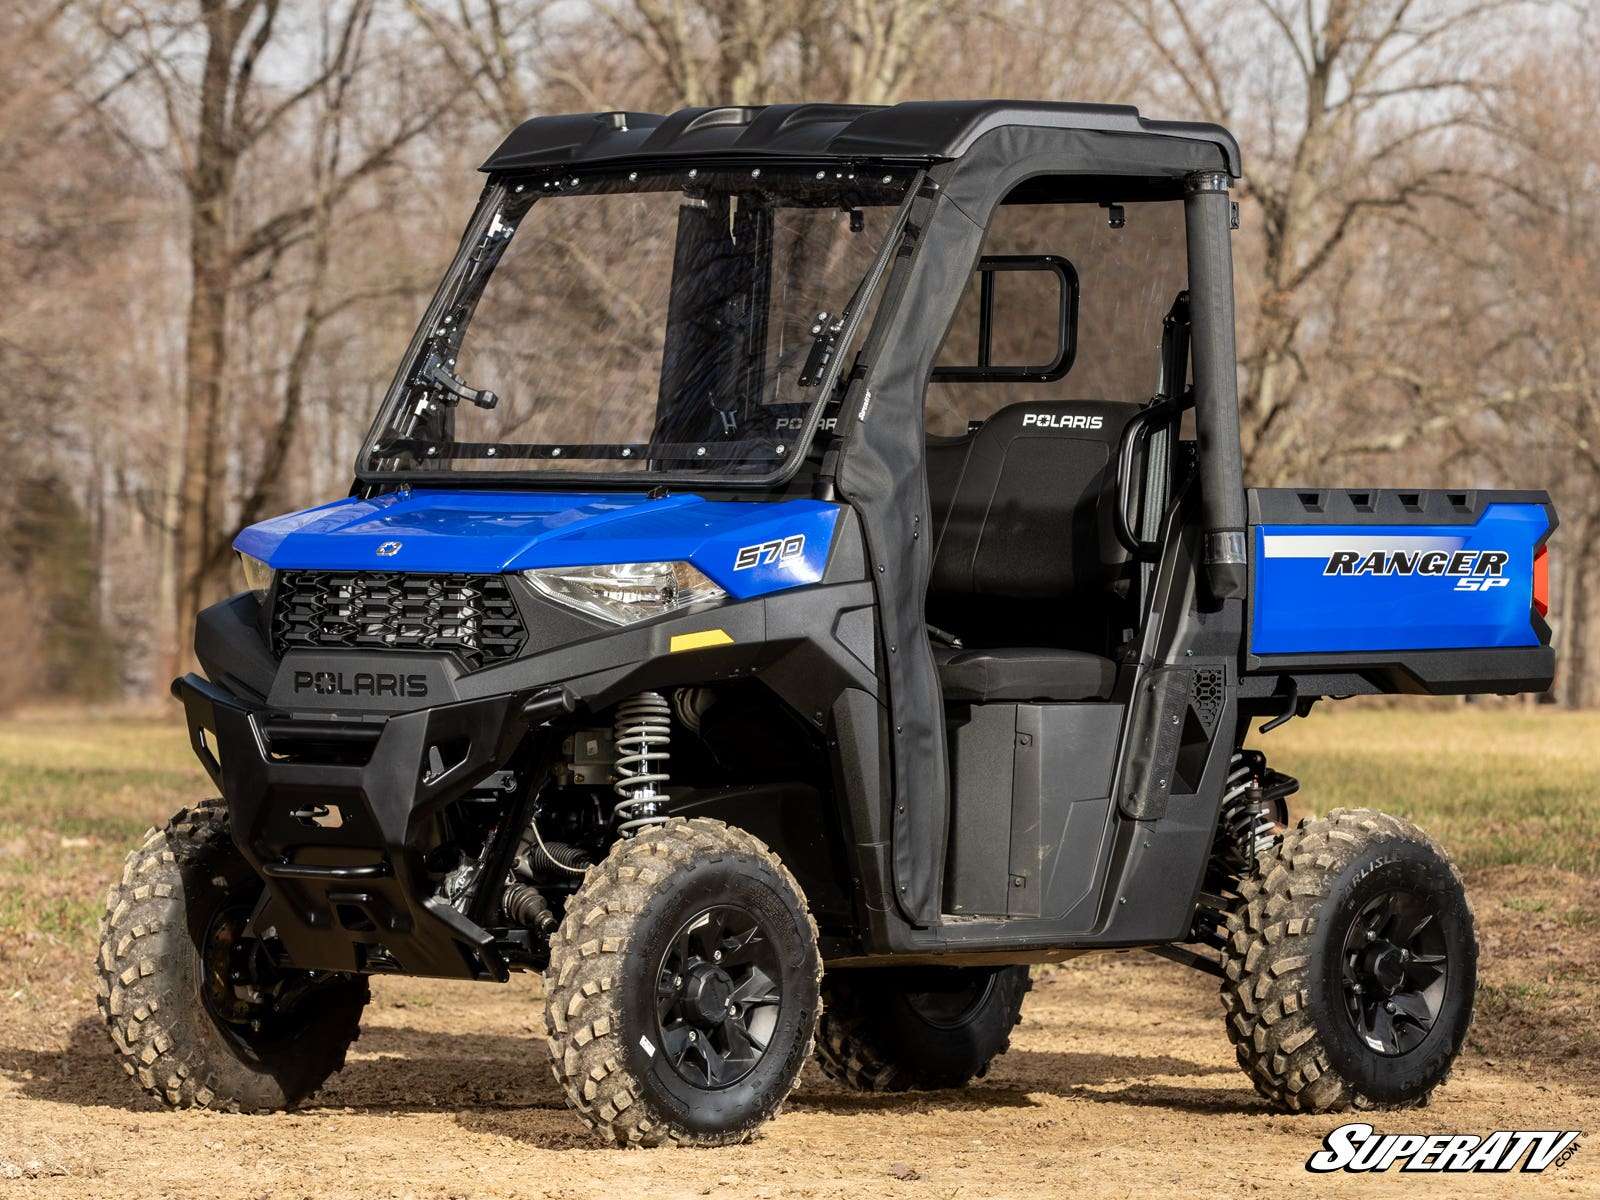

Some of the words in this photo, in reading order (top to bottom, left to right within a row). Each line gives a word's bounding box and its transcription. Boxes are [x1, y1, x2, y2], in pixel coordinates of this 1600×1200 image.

[1022, 413, 1103, 429] POLARIS
[733, 533, 806, 572] 570
[1322, 550, 1509, 577] RANGER
[1454, 577, 1510, 592] SP
[293, 671, 428, 697] POLARIS
